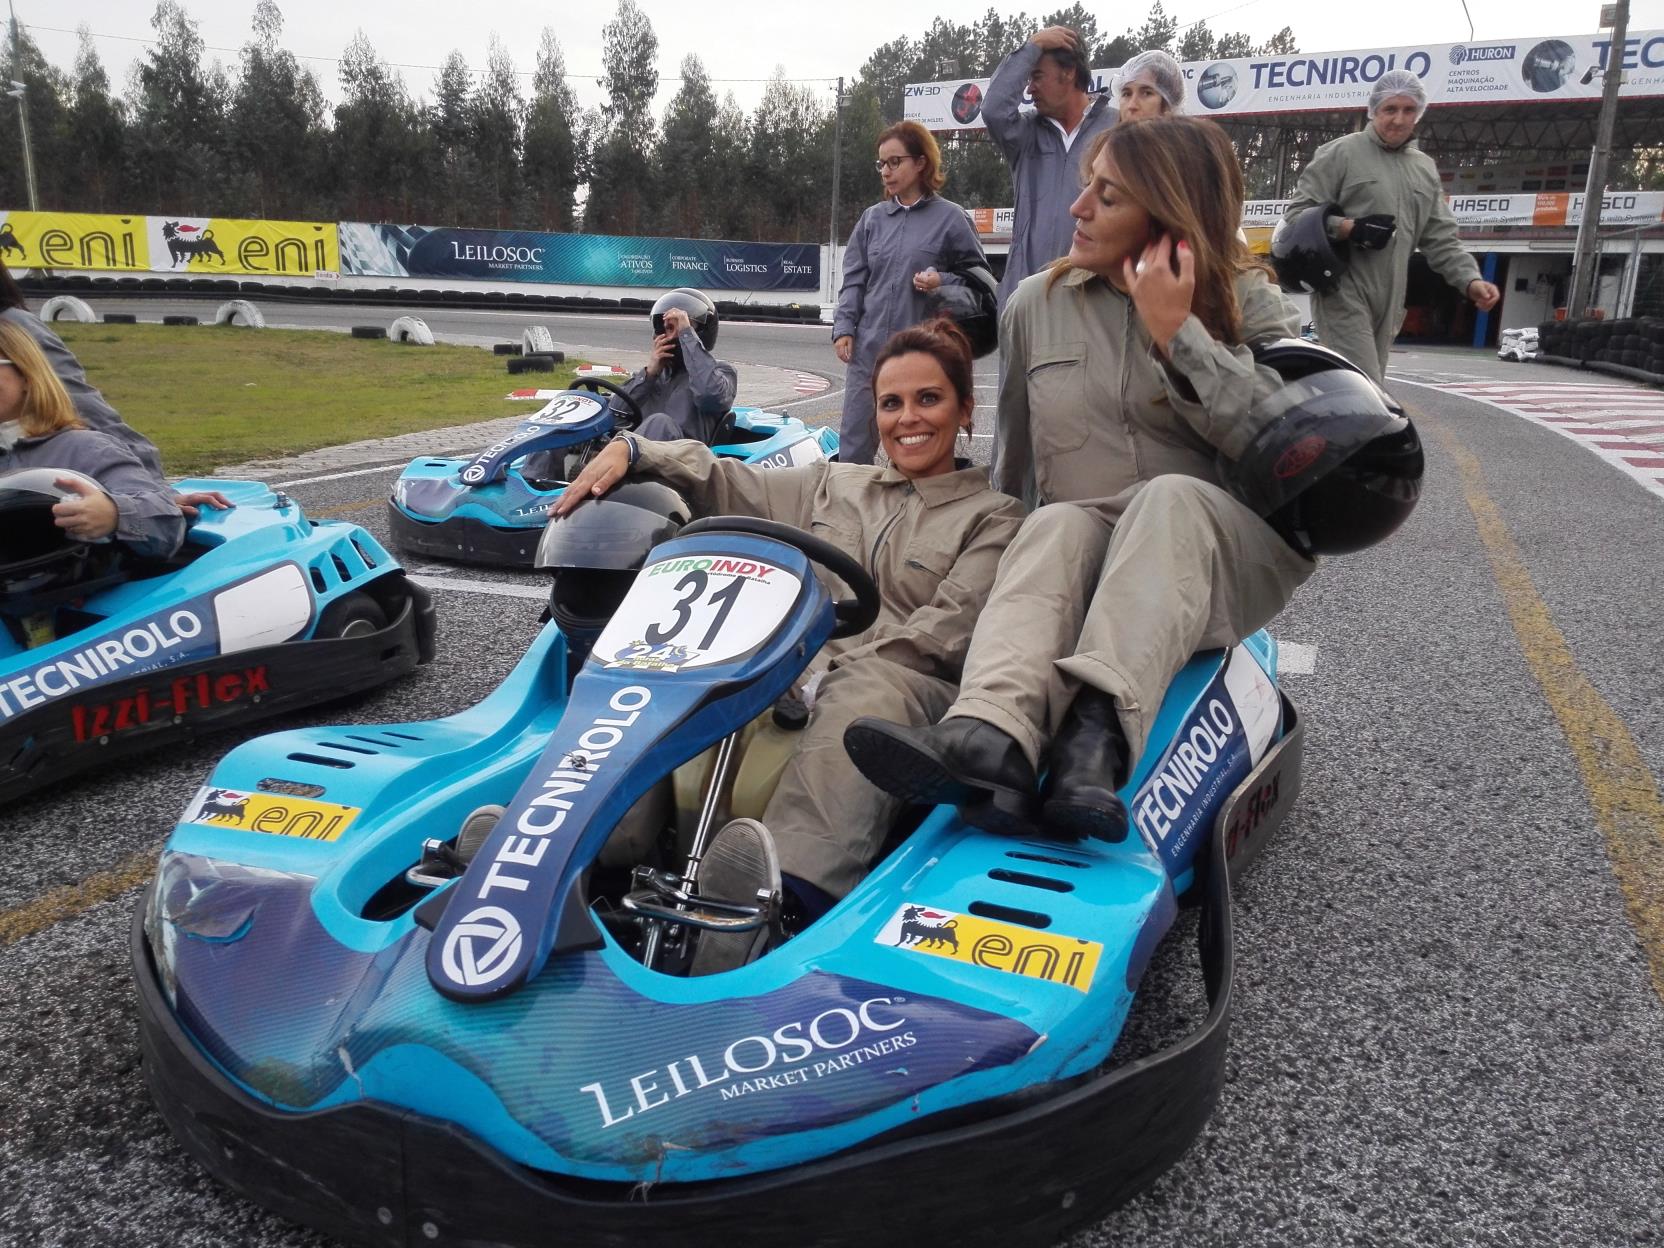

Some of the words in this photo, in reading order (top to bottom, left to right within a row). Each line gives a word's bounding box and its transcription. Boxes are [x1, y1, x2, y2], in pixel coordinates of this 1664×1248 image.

[1471, 47, 1512, 60] HURON
[1448, 69, 1480, 77] CENTROS
[905, 86, 941, 97] ZW3D
[1268, 93, 1321, 103] ENGENHARIA
[1325, 91, 1371, 99] INDUSTRIA
[1465, 84, 1509, 92] VELOCIDADE
[1452, 198, 1510, 212] HASCO
[1573, 196, 1636, 210] HSCO
[40, 218, 135, 268] eni
[238, 225, 326, 272] eni
[451, 241, 543, 263] LEILOSOC
[488, 262, 513, 270] MARKET
[514, 263, 544, 271] PARTNERS
[620, 260, 653, 269] ATIVOS
[672, 261, 709, 271] FINANCE
[726, 263, 768, 273] LOGISTICS
[783, 265, 813, 274] ESTATE
[540, 399, 580, 420] 32
[648, 557, 777, 579] EUROINDY
[645, 569, 747, 651] 31
[0, 610, 202, 718] TECNIROLO
[1137, 699, 1233, 850] TECNIROLO
[477, 685, 652, 899] TECNIROLO
[251, 806, 350, 841] eni
[1171, 807, 1203, 858] ENGENHARIA
[971, 932, 1089, 987] eni
[580, 997, 905, 1129] LEILOSOC
[720, 1068, 808, 1101] MARKET
[815, 1031, 917, 1078] PARTNERS
